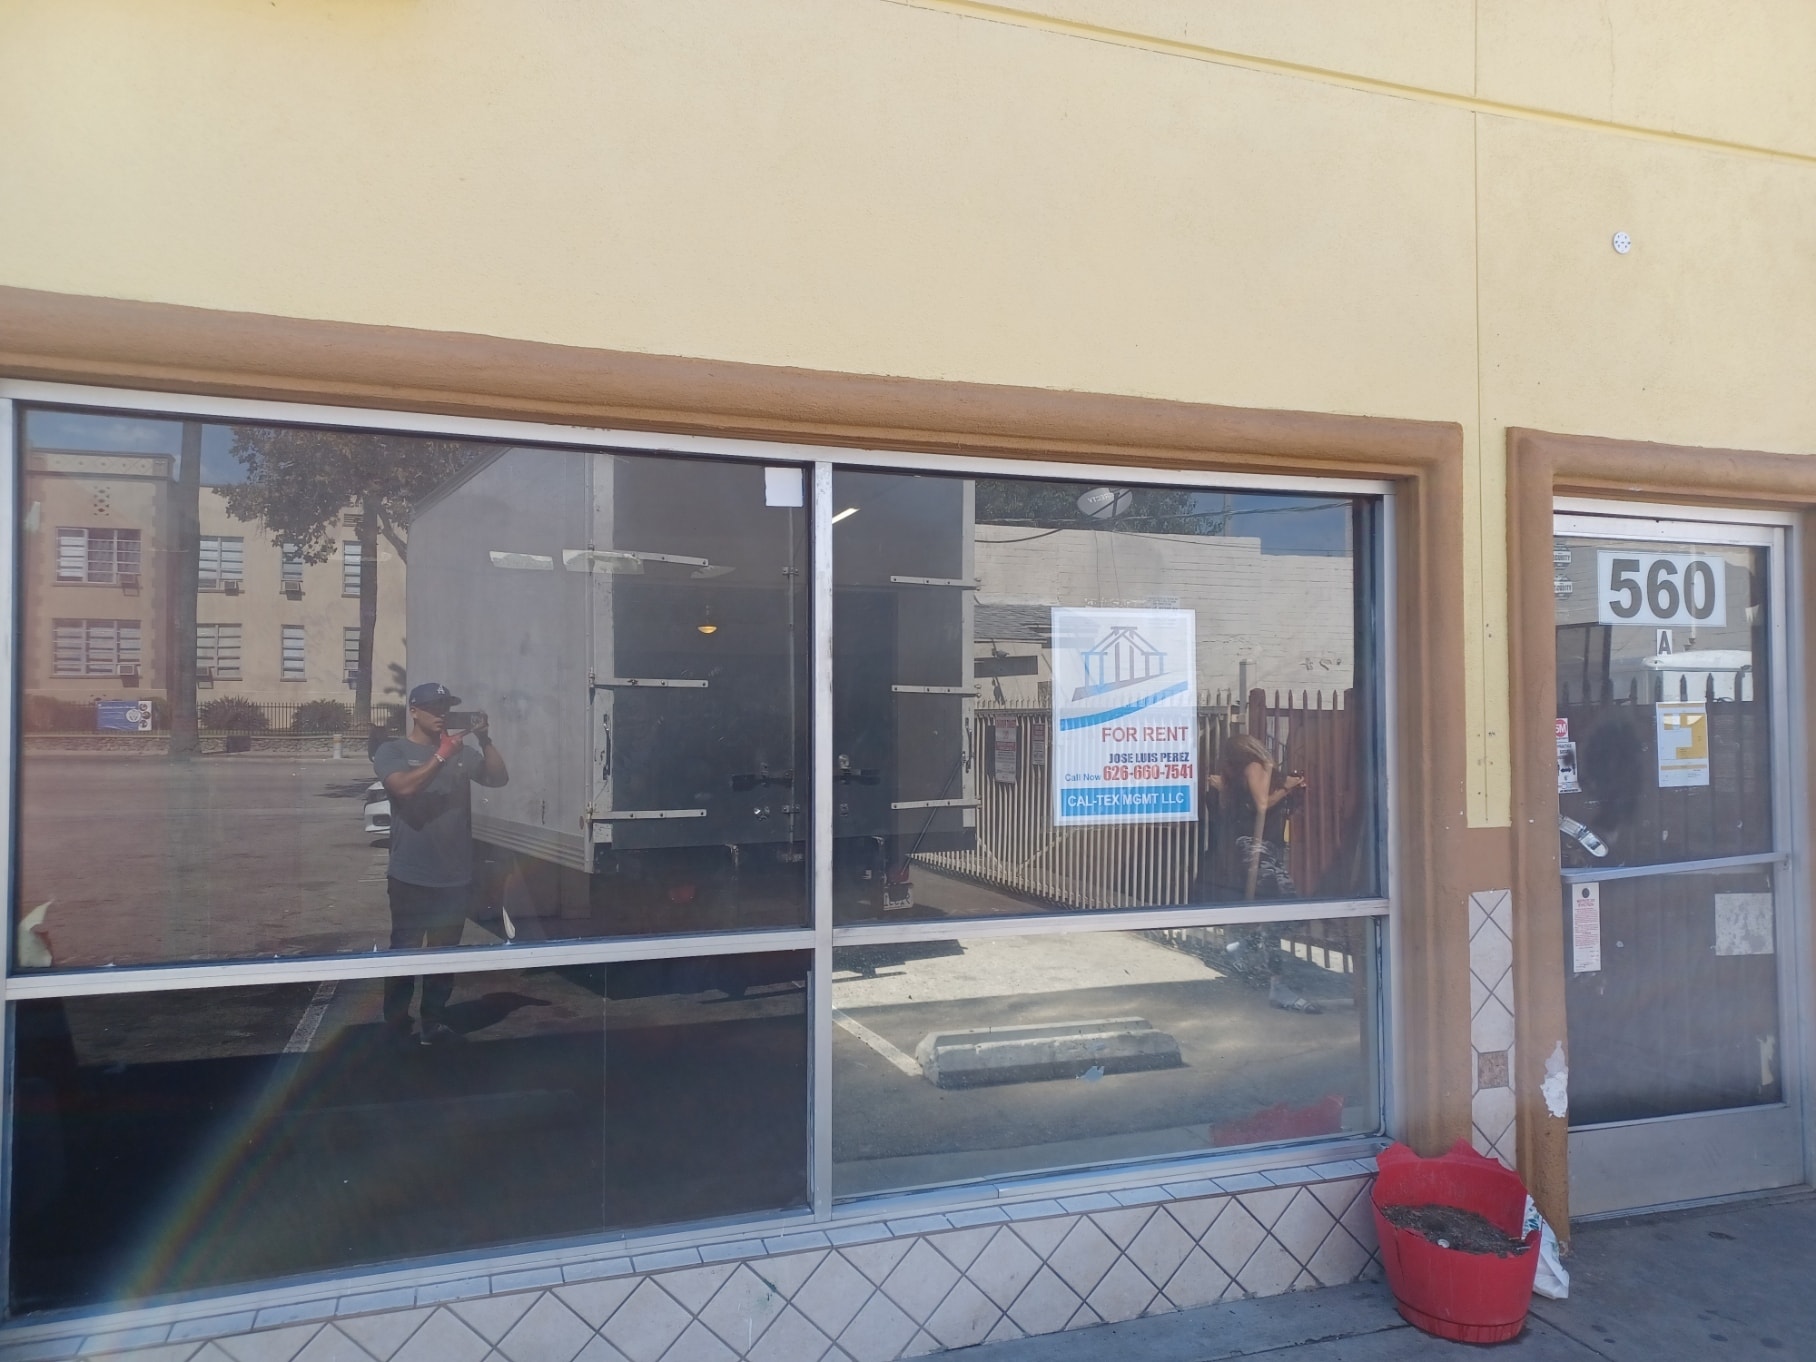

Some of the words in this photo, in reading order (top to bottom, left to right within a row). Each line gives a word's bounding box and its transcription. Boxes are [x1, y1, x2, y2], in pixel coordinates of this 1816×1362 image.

[1609, 558, 1715, 620] 560
[1658, 631, 1671, 655] A
[1102, 727, 1138, 742] FOR
[1143, 726, 1189, 742] RENT
[1109, 753, 1133, 764] JOSE
[1135, 752, 1158, 763] LUIS
[1160, 752, 1190, 763] PEREZ
[1083, 773, 1101, 781] Now
[1103, 764, 1194, 781] 626-660-7541
[1067, 794, 1120, 807] CAL-TEX
[1122, 793, 1159, 806] MGMT
[1161, 792, 1185, 804] LLC
